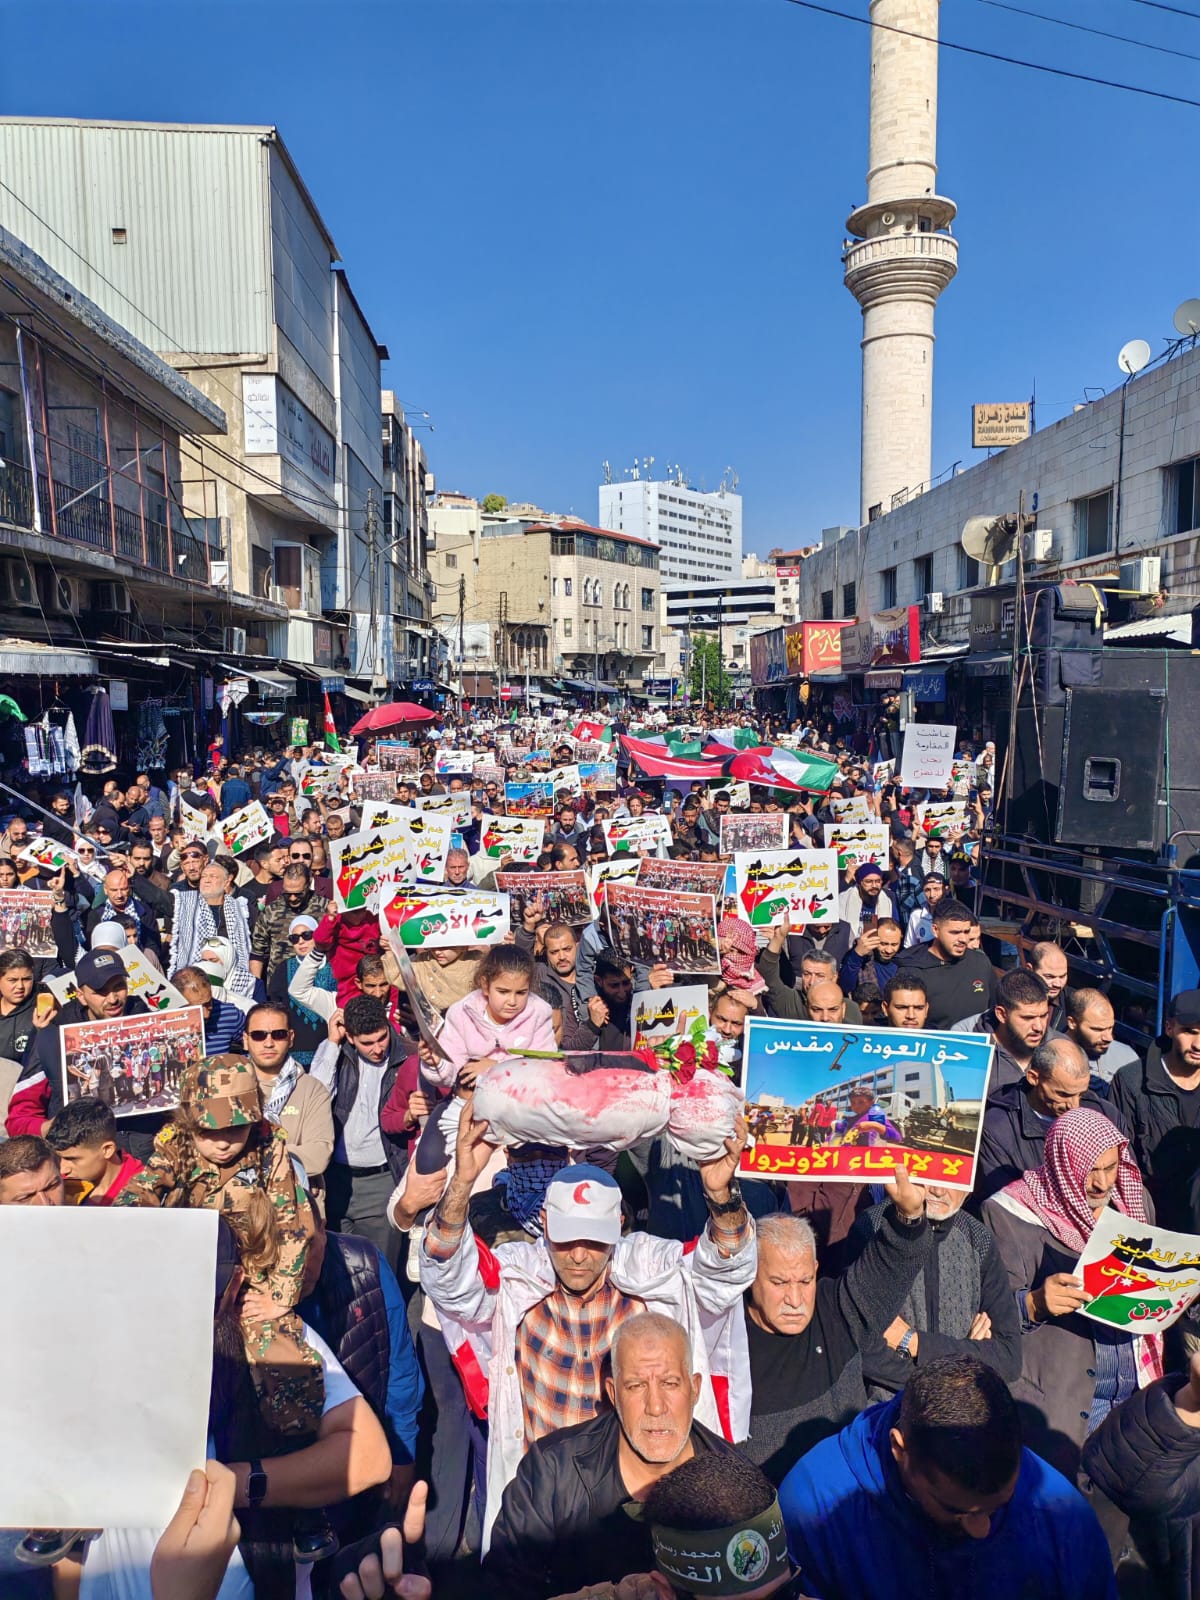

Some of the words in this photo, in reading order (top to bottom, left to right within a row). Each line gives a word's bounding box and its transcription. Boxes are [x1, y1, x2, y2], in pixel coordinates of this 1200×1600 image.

[977, 407, 1002, 424] زهران
[1004, 406, 1026, 423] فندق
[977, 426, 1004, 434] ZAHRAN
[1005, 425, 1026, 433] HOTEL
[917, 728, 950, 738] عاشت
[915, 739, 950, 751] المقاومة
[383, 848, 407, 867] إعلان
[744, 863, 775, 876] الغربية
[777, 861, 808, 872] الضفة
[809, 862, 830, 873] ضم
[615, 886, 627, 896] غزة
[747, 882, 769, 895] على
[772, 881, 797, 892] حرب
[799, 877, 829, 892] إعلان
[392, 898, 422, 909] على
[428, 898, 458, 907] حرب
[461, 897, 498, 908] إعلان
[640, 892, 672, 902] الحصار
[673, 897, 701, 905] كسر
[639, 900, 666, 912] الأنظمة
[668, 905, 702, 916] مسؤولية
[768, 892, 806, 917] الأردن
[421, 908, 468, 937] الأردن
[159, 1012, 189, 1023] كسر
[98, 1023, 119, 1036] على
[116, 1017, 157, 1032] الحصار
[79, 1027, 96, 1038] غزة
[115, 1029, 151, 1044] الأنظمة
[153, 1025, 191, 1039] مسؤولية
[80, 1036, 113, 1049] العربية
[764, 1035, 834, 1055] مقدس
[862, 1037, 927, 1059] العودة
[931, 1044, 969, 1065] حق
[748, 1143, 840, 1175] الأونروا
[848, 1149, 934, 1178] لإلغاء
[941, 1157, 965, 1177] لا
[1110, 1234, 1177, 1263] الغربية
[1100, 1264, 1148, 1283] على
[1154, 1278, 1198, 1292] حرب
[680, 1550, 721, 1559] محمد
